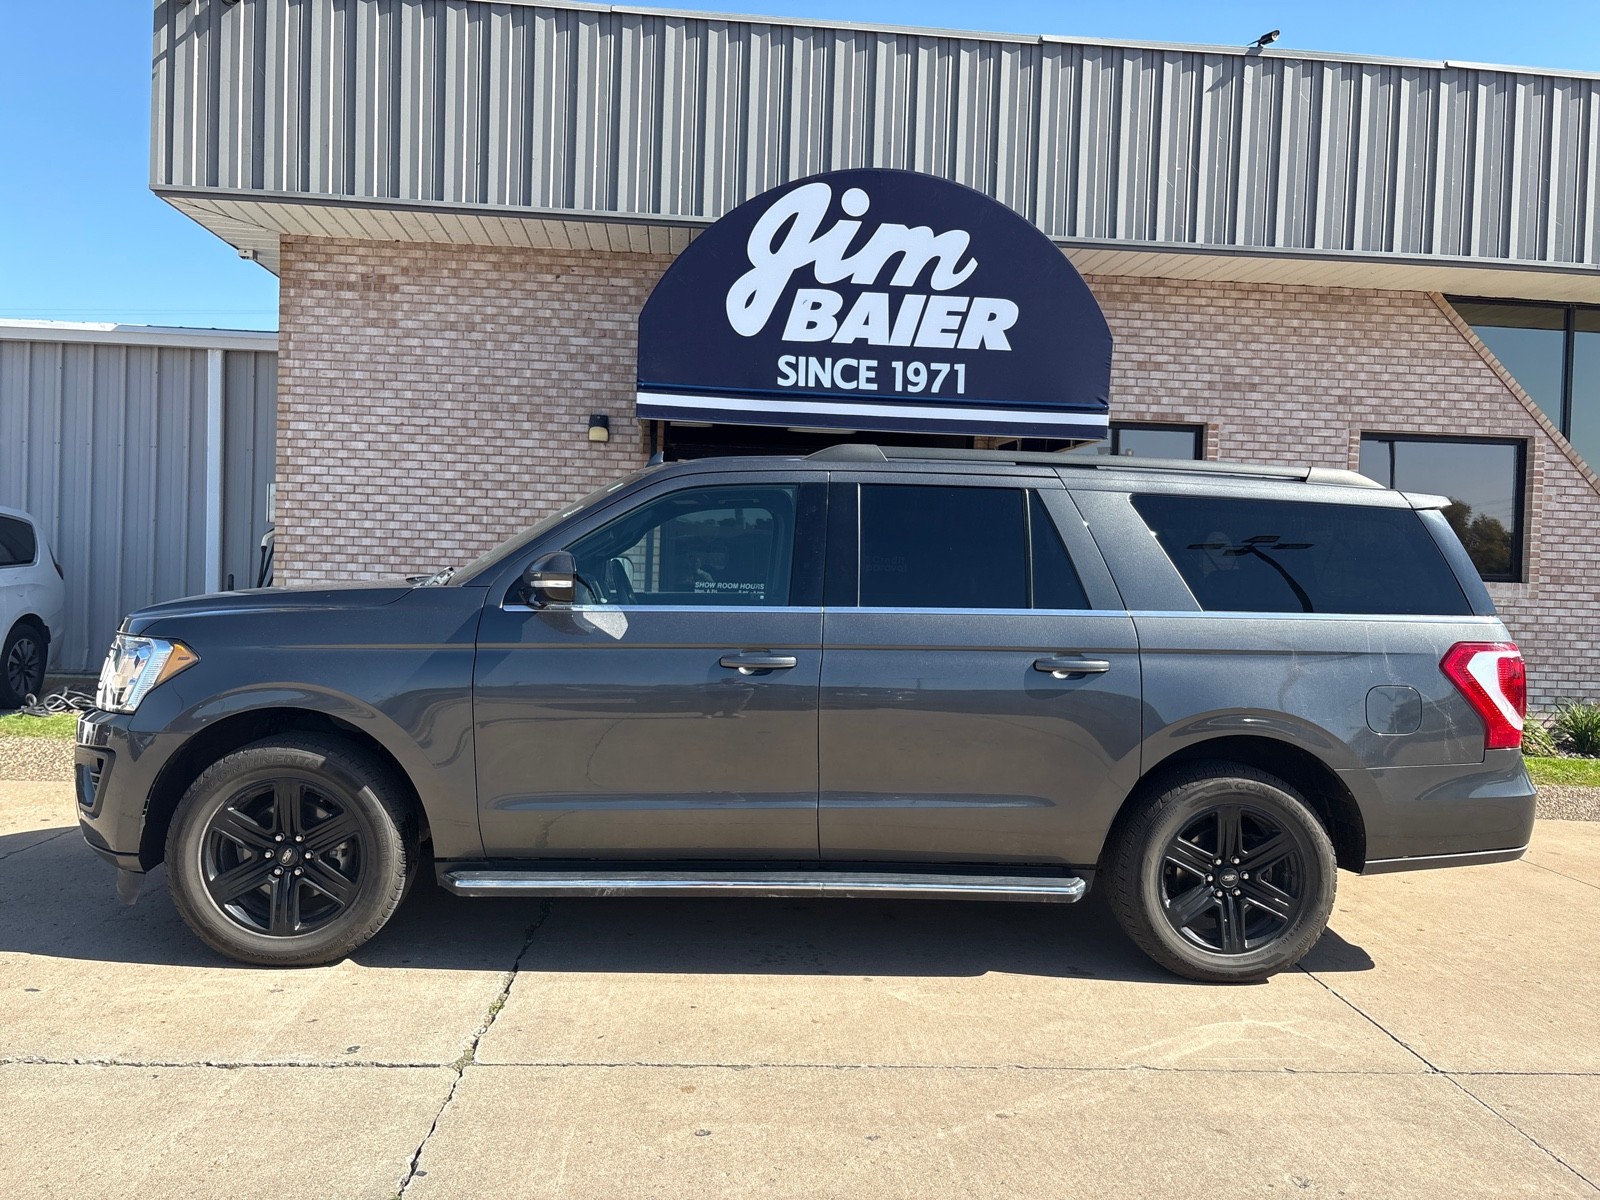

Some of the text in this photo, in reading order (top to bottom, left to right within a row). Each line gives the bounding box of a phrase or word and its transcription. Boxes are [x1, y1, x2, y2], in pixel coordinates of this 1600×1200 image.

[781, 288, 1019, 351] BAIER
[776, 355, 966, 395] SINCE 1971
[694, 581, 716, 589] SHOW
[717, 582, 739, 590] ROOM
